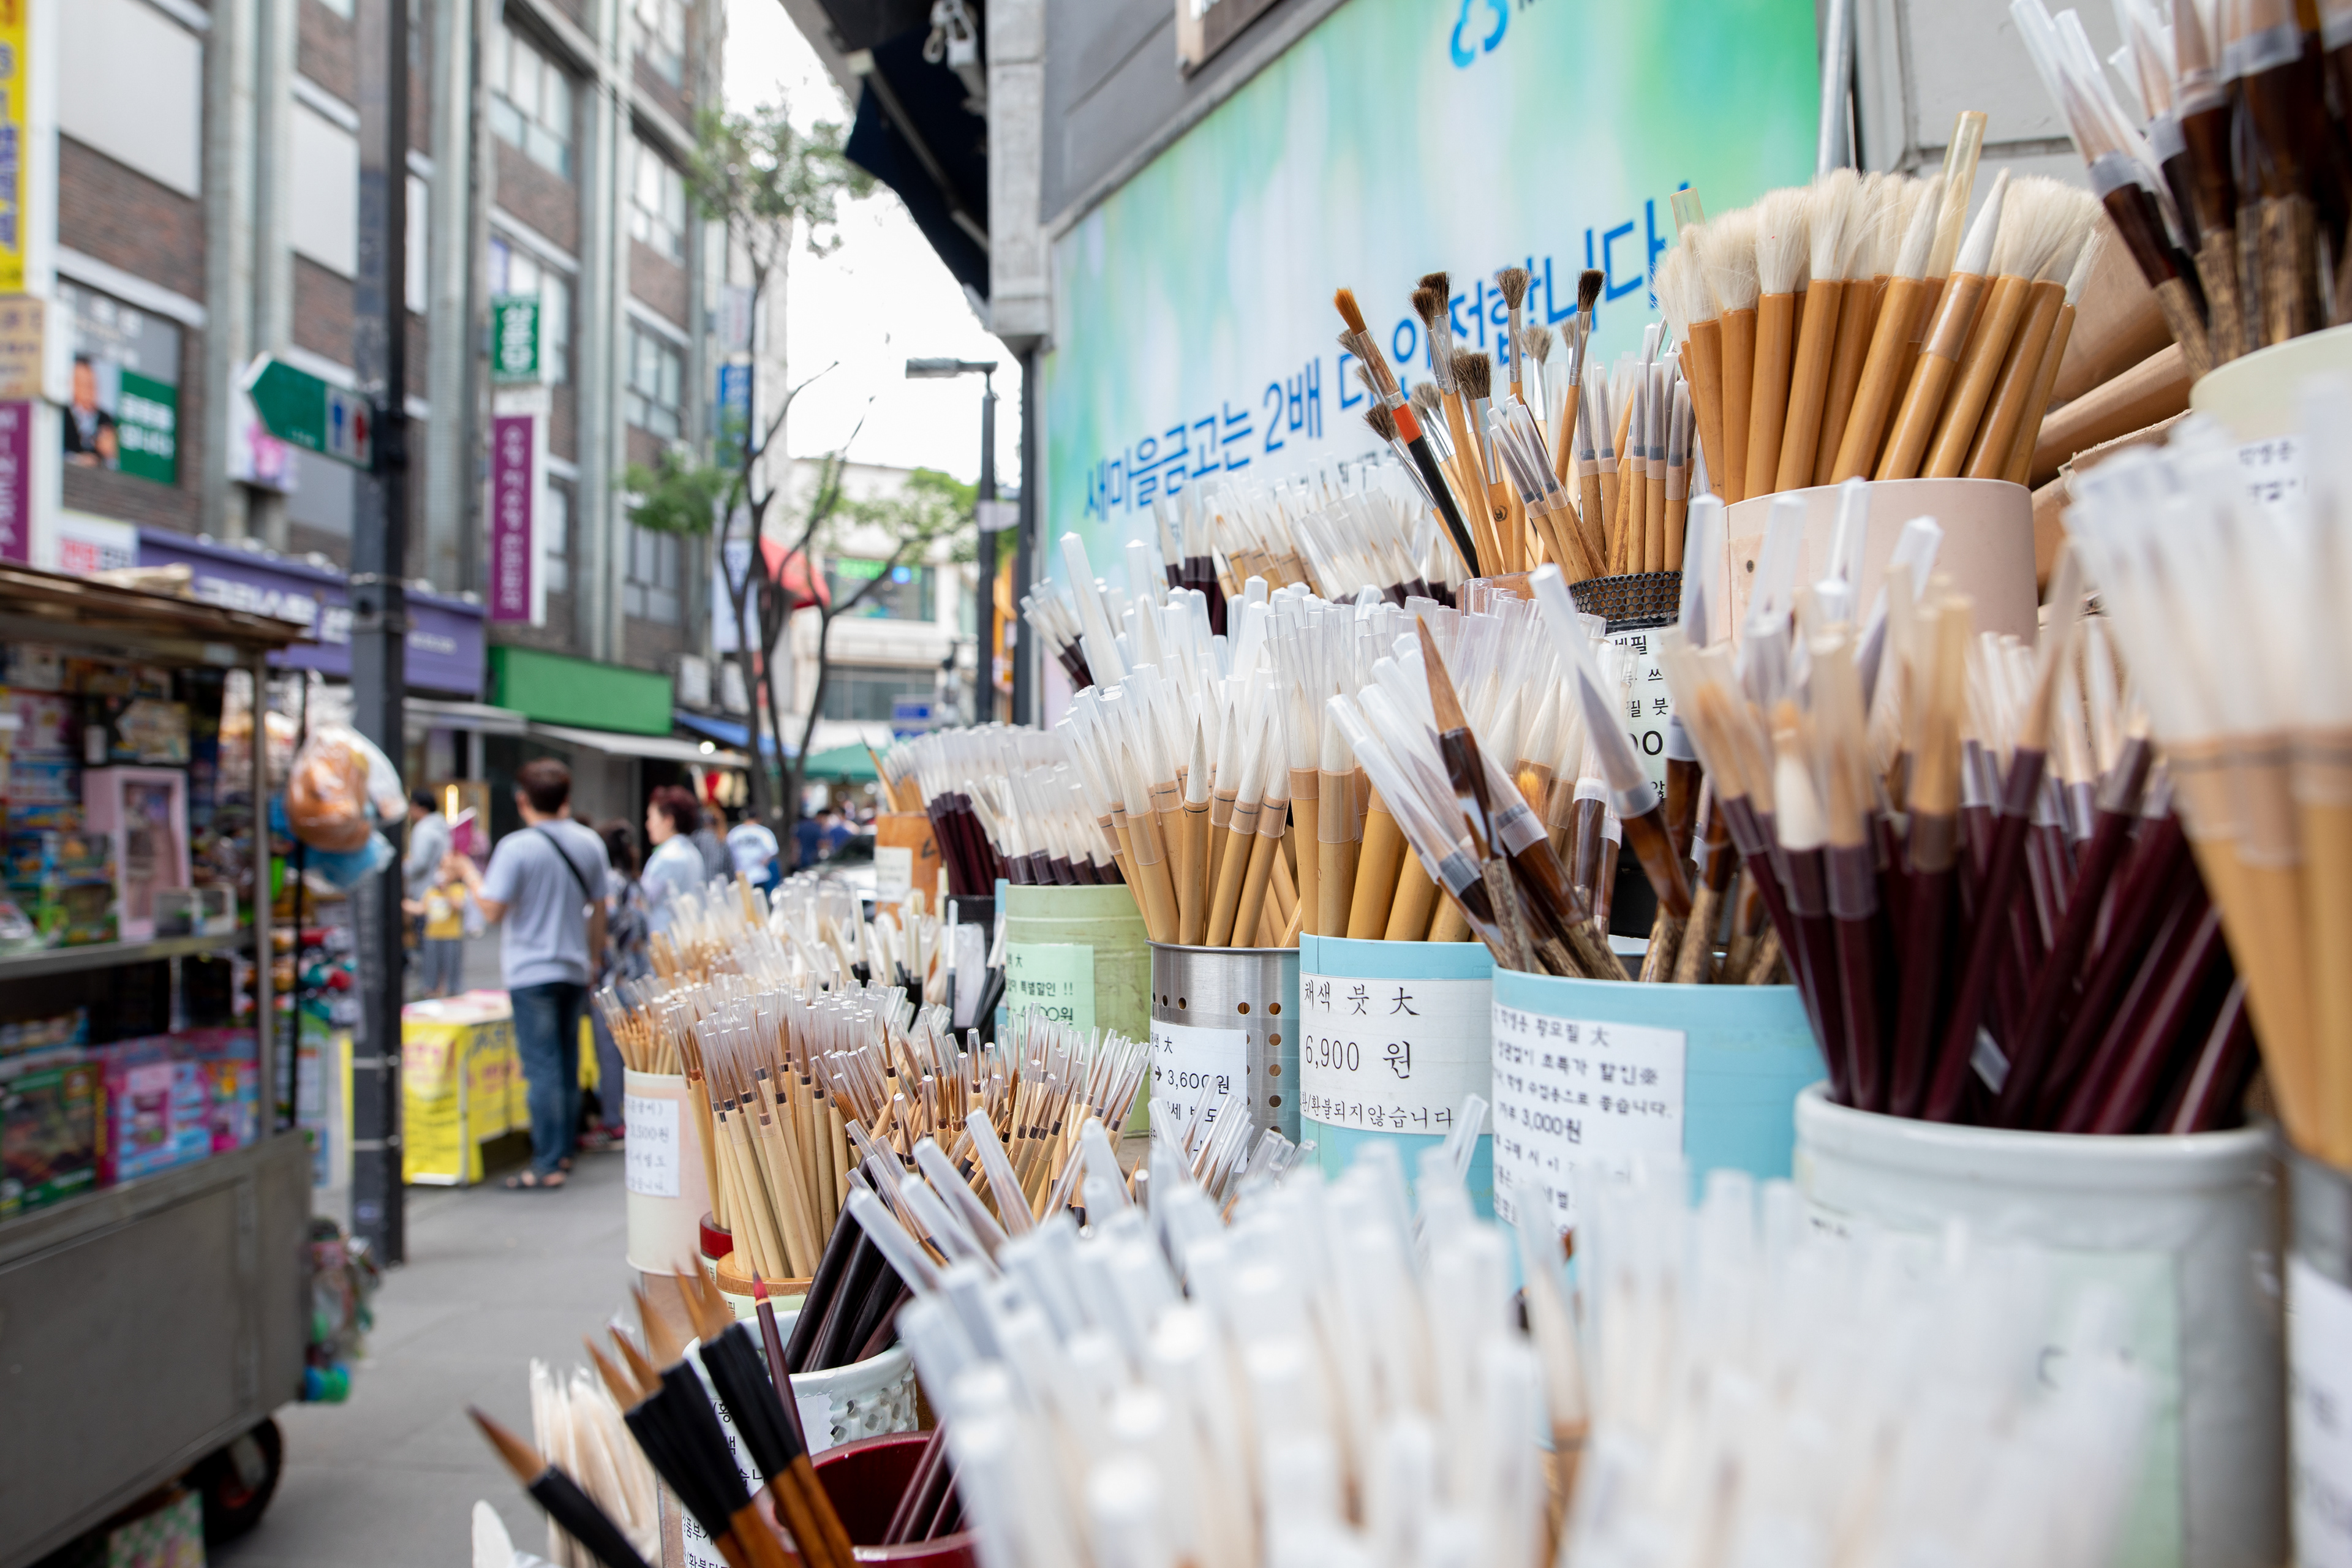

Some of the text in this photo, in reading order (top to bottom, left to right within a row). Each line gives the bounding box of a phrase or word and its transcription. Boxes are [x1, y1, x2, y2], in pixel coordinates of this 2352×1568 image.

[1083, 402, 1254, 523] 새마을금고는
[1263, 356, 1322, 453] 2배
[1652, 697, 1669, 715] 붓
[1020, 980, 1056, 997] 특별할인
[1304, 979, 1420, 1016] 채색 붓 大
[1164, 1036, 1173, 1054] 大
[1589, 1025, 1610, 1049] 大
[1305, 1035, 1411, 1079] 6,900 원
[1300, 1090, 1455, 1130] 환/환불되지않습니다
